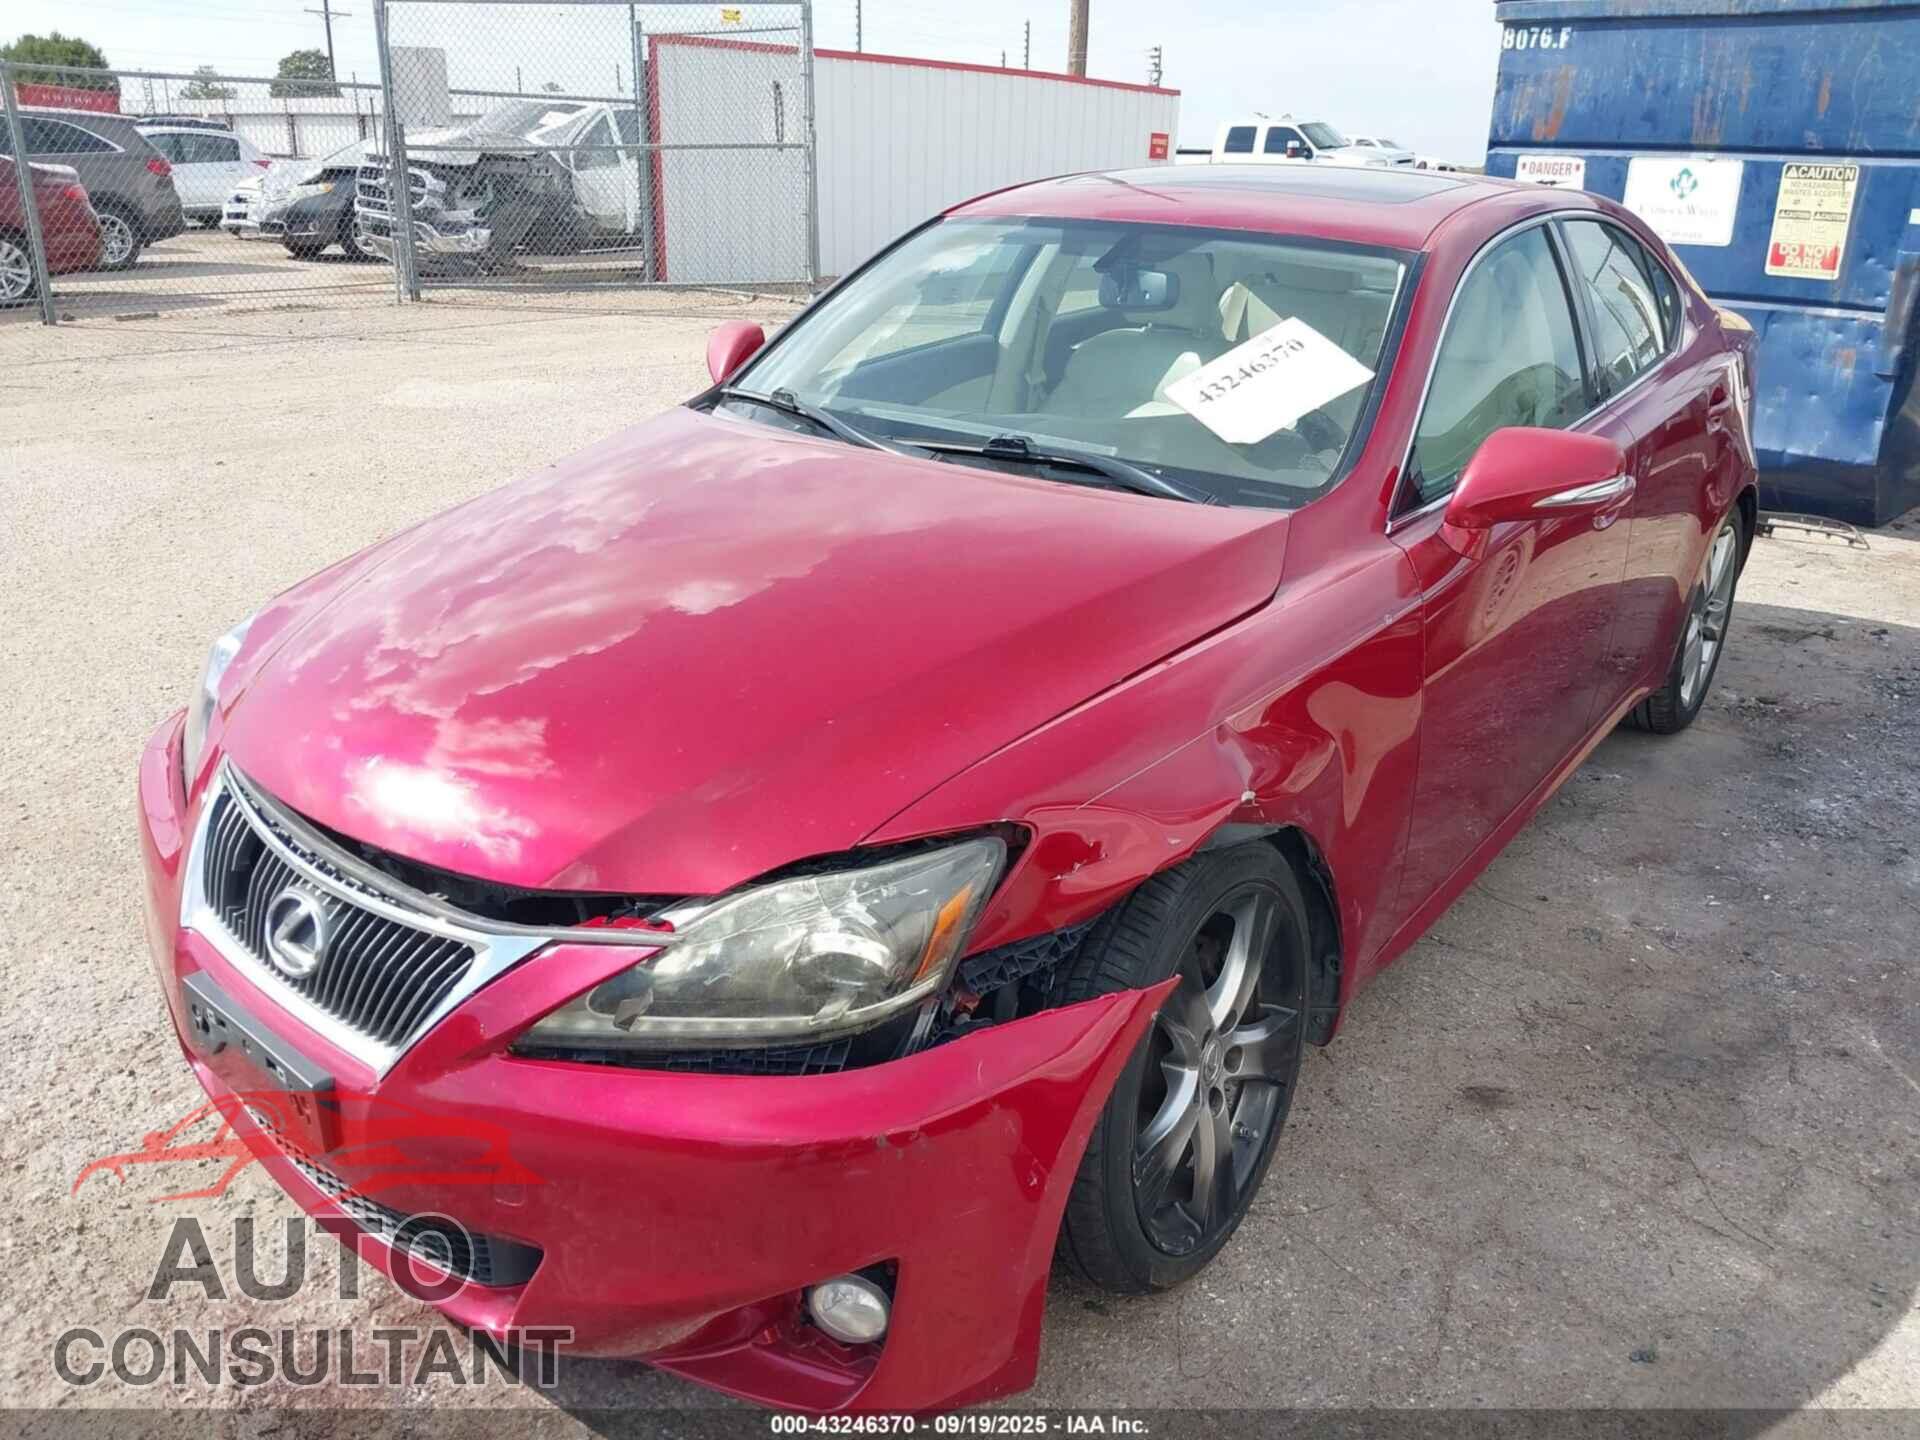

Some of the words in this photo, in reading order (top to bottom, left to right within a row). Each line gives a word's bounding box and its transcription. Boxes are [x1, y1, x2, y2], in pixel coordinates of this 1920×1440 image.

[1528, 161, 1573, 176] DANGER
[1798, 166, 1856, 181] CAUTION
[1778, 244, 1801, 256] DO
[1804, 245, 1836, 258] NOT
[1784, 256, 1824, 270] PARK
[1199, 338, 1306, 404] 43246370
